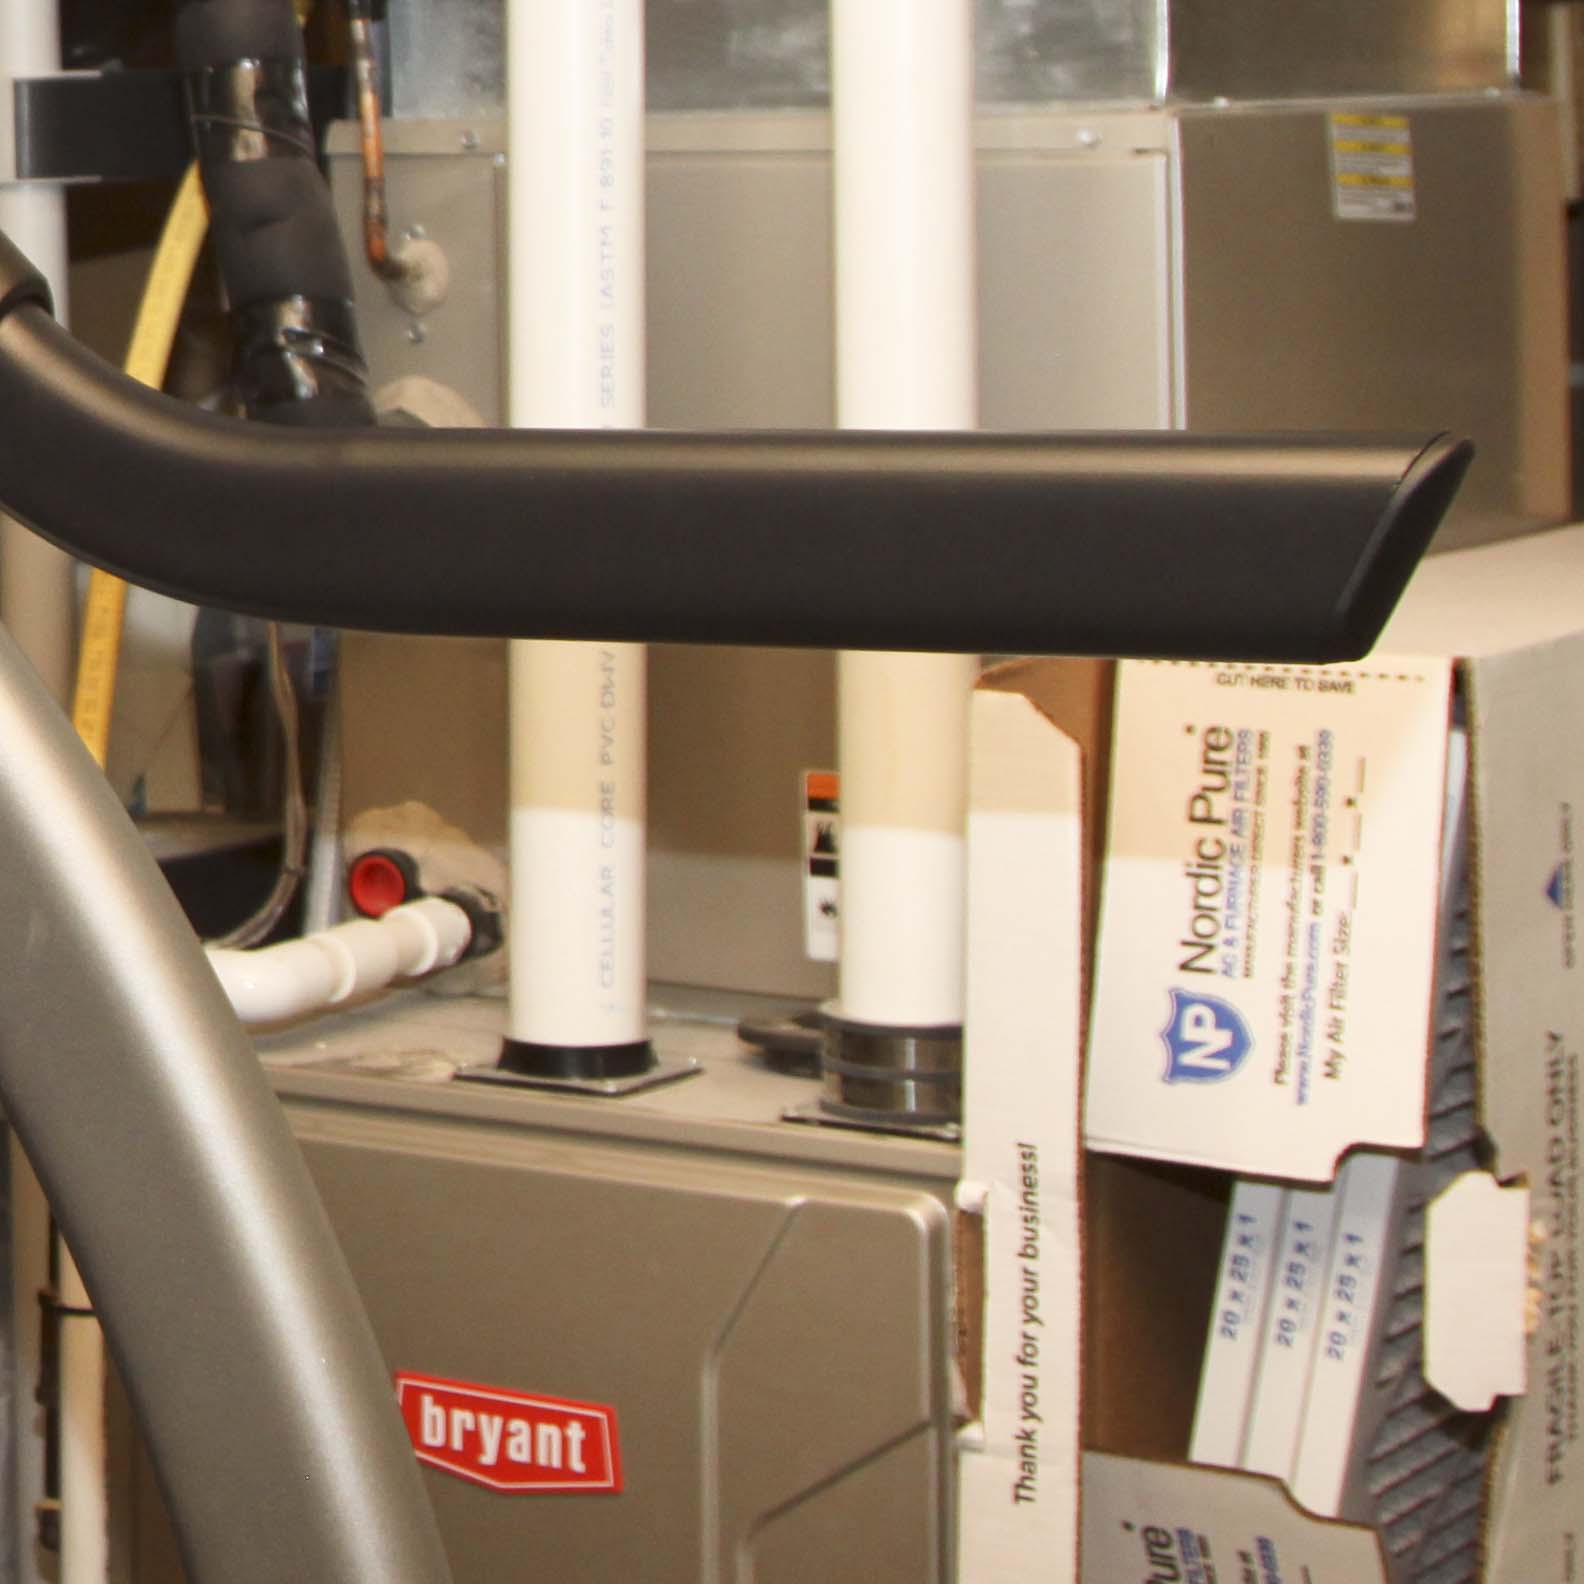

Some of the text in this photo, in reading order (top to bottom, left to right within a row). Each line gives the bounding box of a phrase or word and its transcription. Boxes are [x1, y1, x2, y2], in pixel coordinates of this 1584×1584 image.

[1216, 672, 1355, 695] CUT HERE TO SAVE
[1233, 729, 1253, 802] FILTERS
[599, 780, 616, 849] CORE
[1230, 807, 1246, 838] AIR
[1179, 725, 1235, 974] Nordic Pure
[1223, 844, 1242, 930] FURNACE
[1310, 864, 1326, 893] call
[1273, 745, 1309, 1085] Please visit the manufacturers website at
[1311, 898, 1324, 916] or
[1328, 962, 1349, 1010] Filter
[1296, 921, 1320, 1105] www.NordicPure.com
[1177, 1003, 1234, 1070] NP
[1327, 1016, 1344, 1044] Air
[1323, 1047, 1346, 1080] My
[1545, 1030, 1565, 1127] ONLY
[1237, 1213, 1256, 1224] 1
[1293, 1220, 1313, 1232] 1
[1344, 1232, 1363, 1243] 1
[1229, 1254, 1250, 1283] 25
[1286, 1261, 1305, 1290] 25
[1336, 1274, 1357, 1303] 25
[1011, 1142, 1045, 1505] Thank you for your business!
[1220, 1310, 1241, 1341] 20
[1277, 1318, 1296, 1349] 20
[1327, 1331, 1346, 1361] 20
[1545, 1333, 1563, 1485] FRAGILE
[420, 1392, 586, 1474] bryant
[1141, 1525, 1182, 1584] ure
